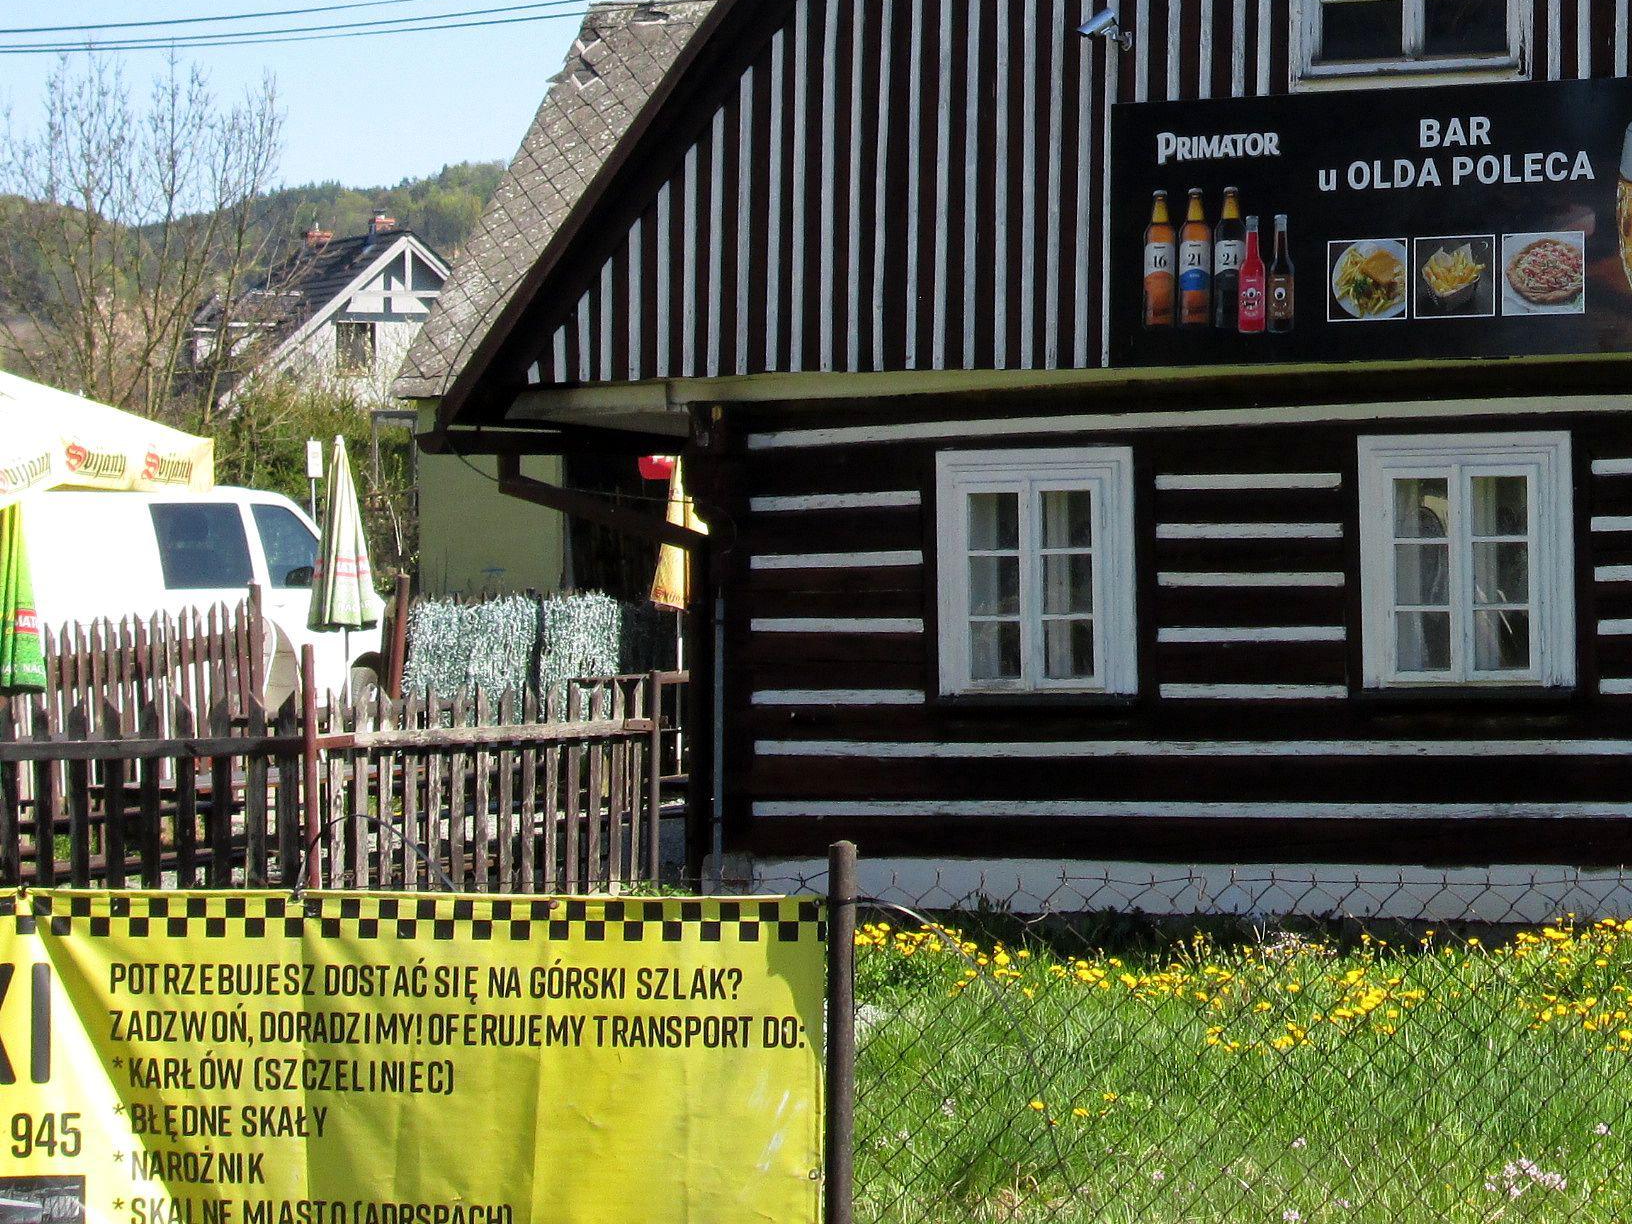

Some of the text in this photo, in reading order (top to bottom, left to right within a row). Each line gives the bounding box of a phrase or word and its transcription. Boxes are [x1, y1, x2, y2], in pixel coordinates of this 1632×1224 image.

[1156, 132, 1281, 165] PRIMATOR
[1419, 116, 1491, 148] BAR
[1318, 150, 1595, 191] u OLDA POLECA
[110, 957, 743, 1004] POTRZEBUJESZ DOSTAĆ SIĘ NA GÓRSKI SZLAK?
[109, 1003, 806, 1049] ZADZWOŃ, DORADZIMY! OFERUJEMY TRANSPORT DO:
[128, 1050, 455, 1095] KARŁÓW (SZCZELINIEC)
[11, 1113, 81, 1158] 945
[131, 1104, 328, 1142] BŁĘDNE SKAŁY
[131, 1145, 265, 1184] NAROŻNIK
[242, 1200, 355, 1224] MIASTO
